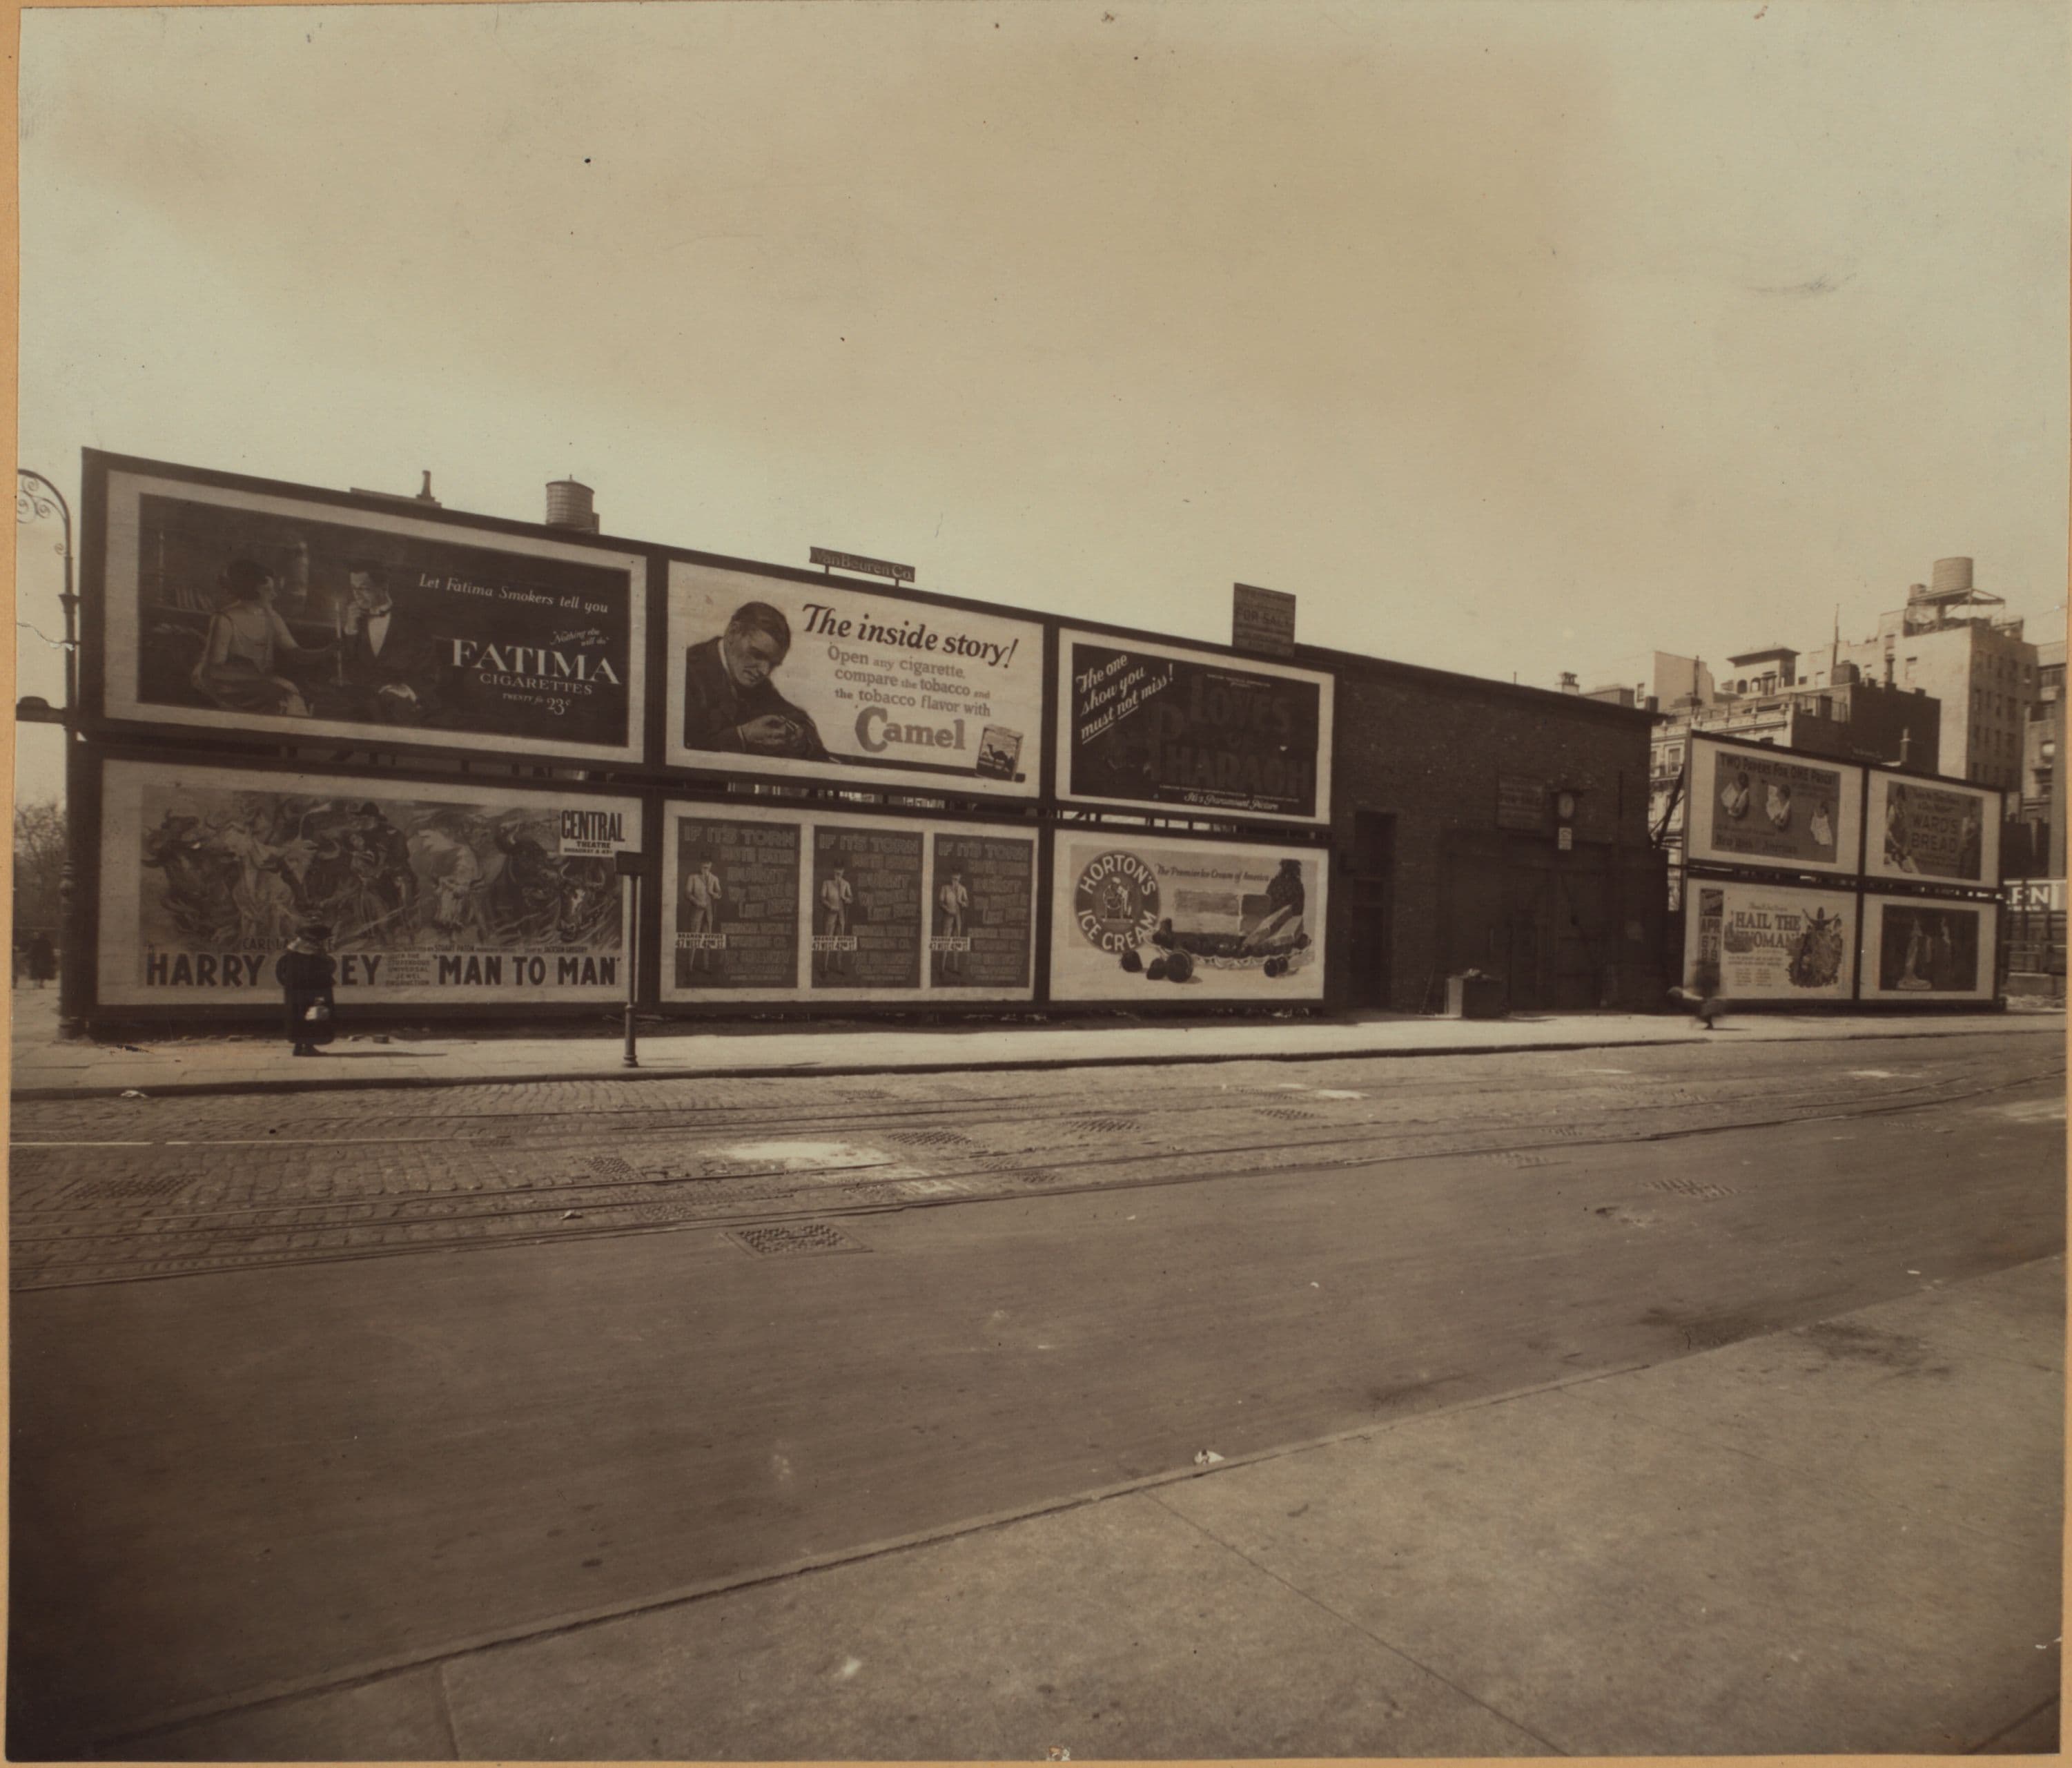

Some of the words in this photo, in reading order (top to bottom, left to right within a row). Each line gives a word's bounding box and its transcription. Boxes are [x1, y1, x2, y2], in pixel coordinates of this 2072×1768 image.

[419, 574, 439, 588] Let
[447, 578, 493, 596] Fatima
[499, 586, 554, 605] Smokers
[560, 595, 580, 609] tell
[585, 602, 608, 614] you
[802, 603, 852, 637] The
[857, 613, 939, 651] inside
[942, 638, 1019, 669] story!
[451, 639, 621, 685] FATIMA
[828, 645, 869, 666] Open
[873, 658, 895, 672] any
[1076, 668, 1104, 694] The
[1106, 654, 1128, 676] one
[480, 673, 593, 695] CIGARETTES
[834, 668, 899, 687] compare
[901, 679, 918, 690] the
[920, 678, 970, 697] tobacco
[974, 690, 990, 699] and
[1080, 689, 1117, 718] show
[1120, 666, 1145, 699] you
[834, 688, 854, 700] the
[859, 688, 916, 707] tobacco
[921, 694, 961, 713] flavor
[964, 701, 991, 717] with
[1081, 706, 1115, 740] must
[1117, 690, 1139, 716] not
[1141, 663, 1173, 701] miss!
[854, 706, 966, 752] Camel
[561, 810, 625, 842] CENTRAL
[740, 828, 796, 847] TORN
[577, 841, 610, 849] THEATRE
[1911, 831, 1956, 854] BREAD
[1079, 854, 1156, 896] HORTON'S
[1155, 862, 1170, 875] The
[1211, 868, 1233, 880] Cream
[1234, 871, 1242, 884] of
[1242, 871, 1270, 882] America
[1078, 909, 1102, 940] ICE
[1102, 910, 1158, 951] CREAM
[1701, 918, 1721, 933] APR
[1735, 911, 1772, 929] HAIL
[1775, 914, 1801, 931] THE
[243, 938, 272, 951] CARL
[146, 953, 266, 987] HARRY
[512, 956, 546, 986] TO
